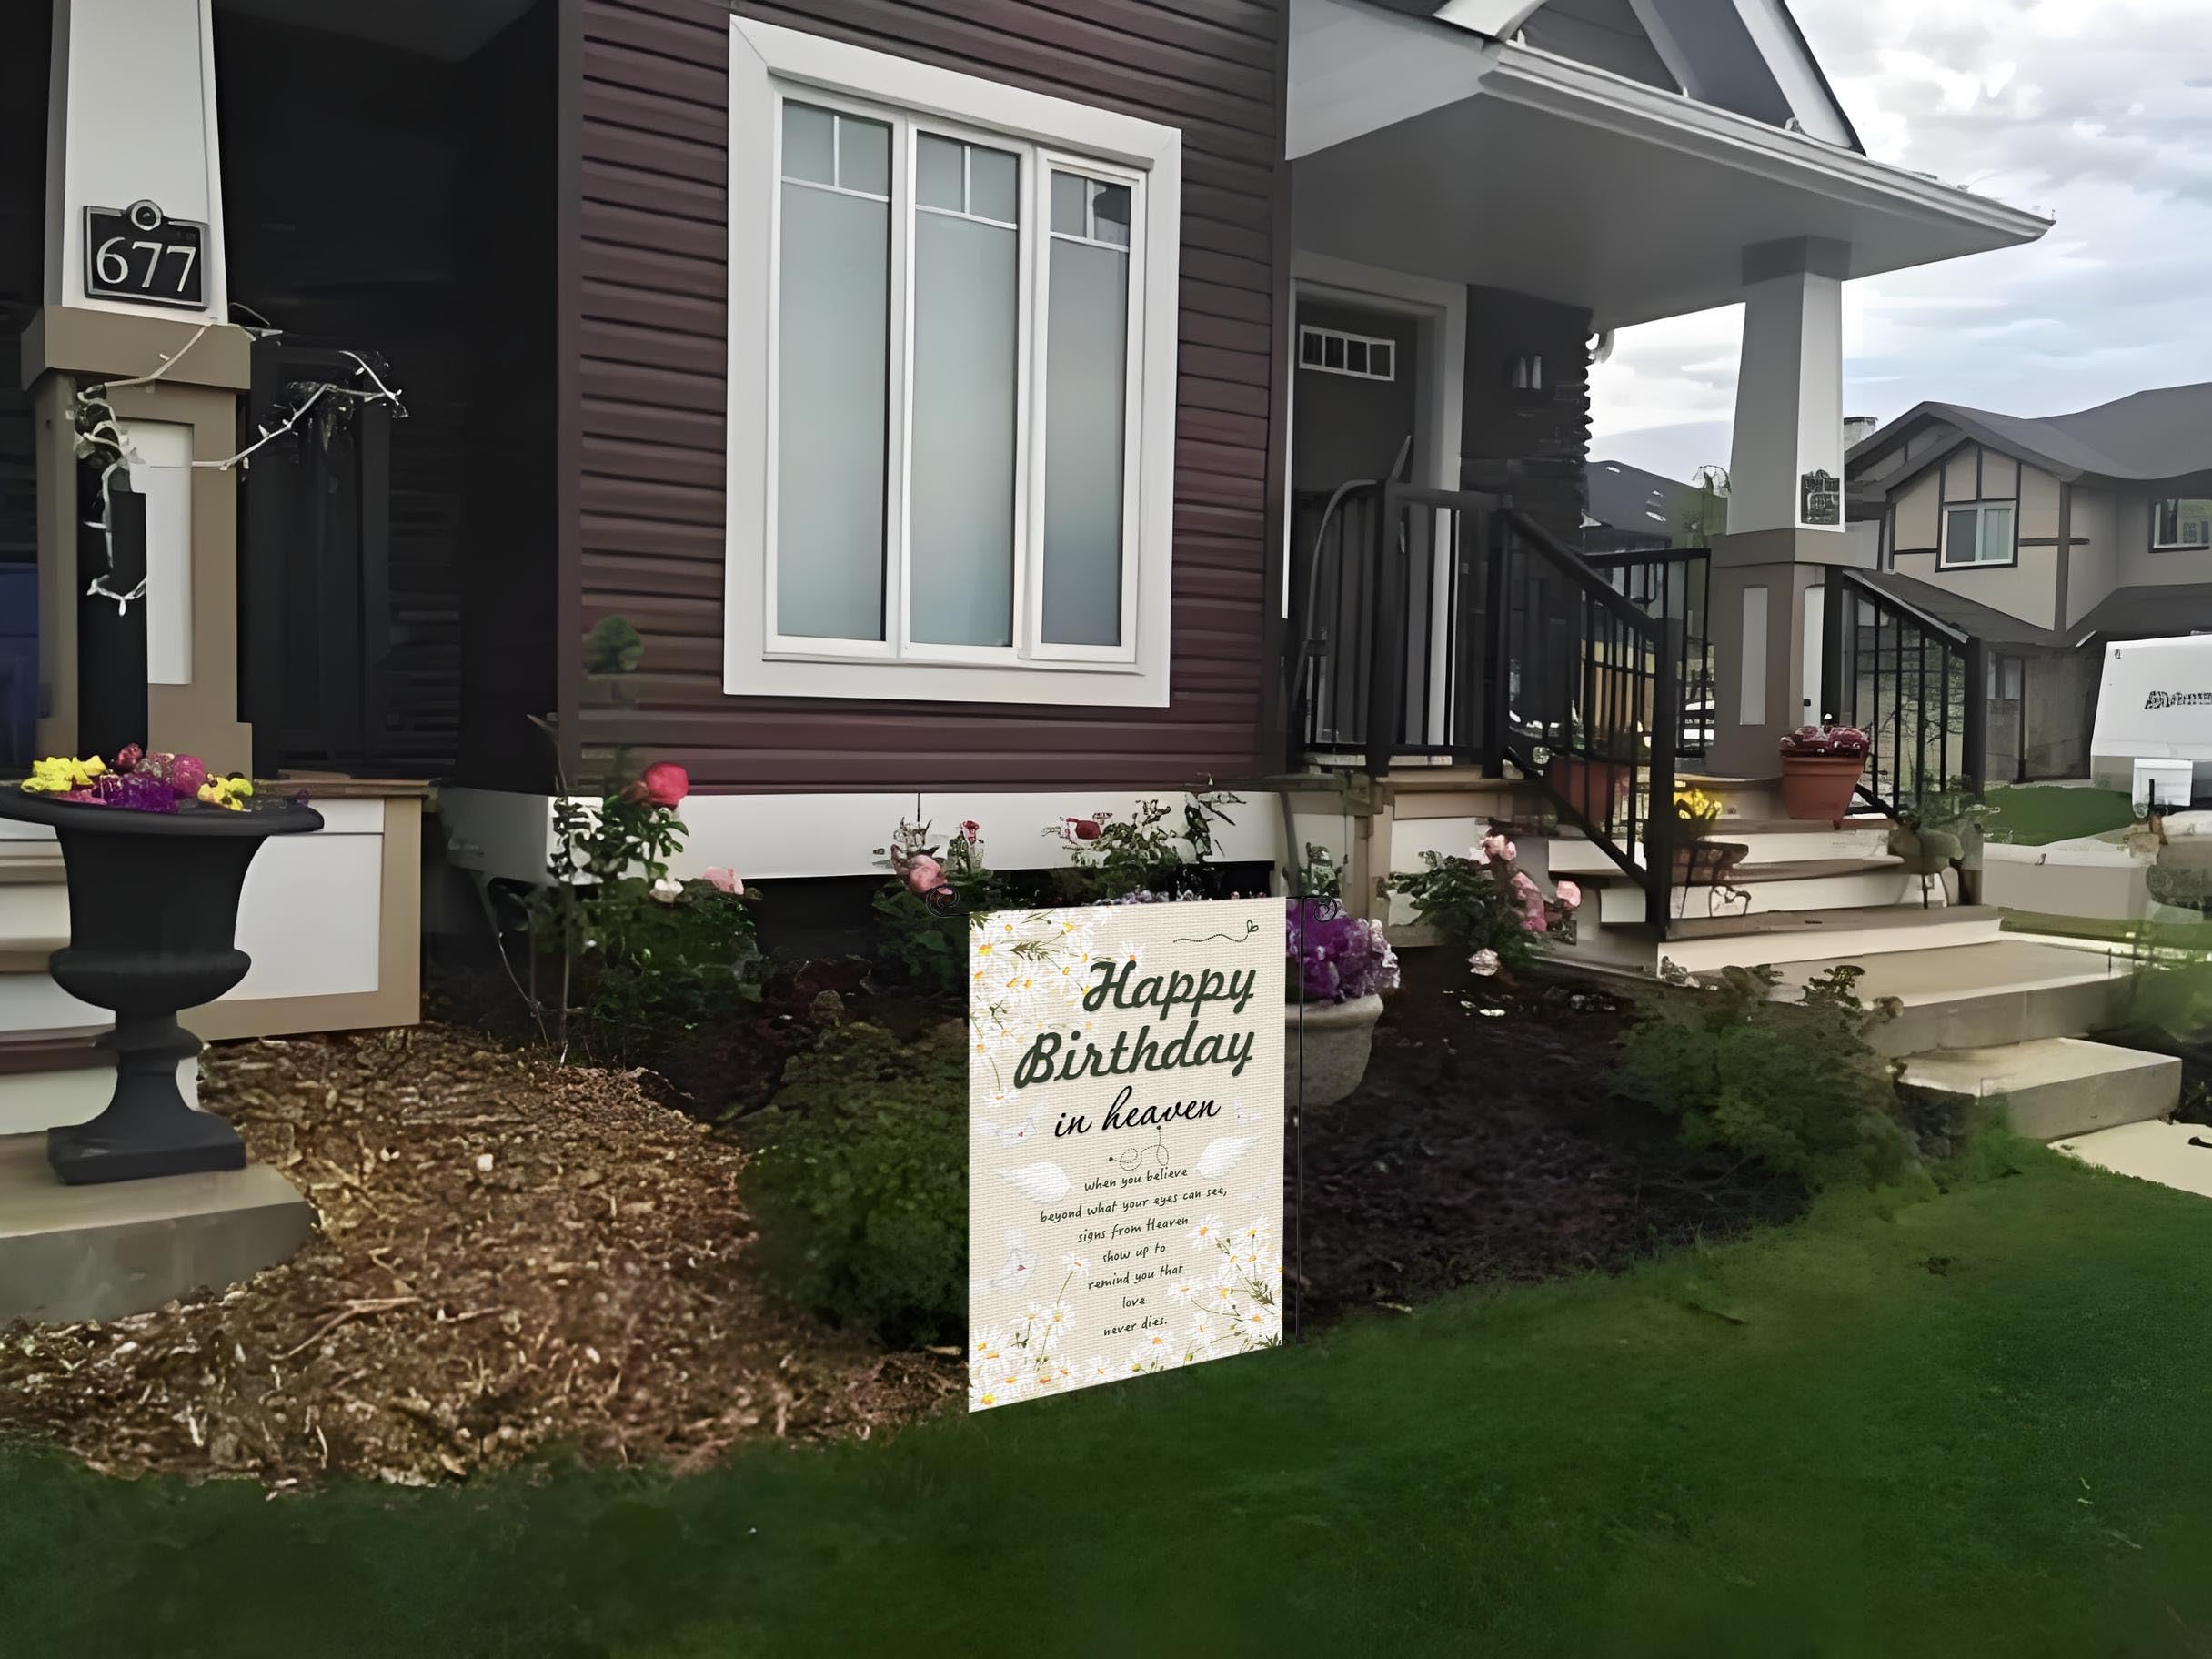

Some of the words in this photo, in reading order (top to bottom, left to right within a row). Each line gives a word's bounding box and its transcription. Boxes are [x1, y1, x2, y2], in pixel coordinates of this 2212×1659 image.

[96, 236, 196, 292] 677
[1082, 960, 1257, 1021] Happy
[1014, 1019, 1255, 1089] Birthday
[1054, 1111, 1092, 1138] in
[1101, 1085, 1222, 1131] heaven
[1084, 1177, 1116, 1191] when
[1121, 1176, 1141, 1190] you
[1146, 1166, 1188, 1182] believe
[1041, 1205, 1082, 1223] beyond
[1087, 1200, 1118, 1215] what
[1121, 1200, 1149, 1212] your
[1152, 1192, 1178, 1206] eyes
[1182, 1191, 1202, 1201] can
[1206, 1187, 1228, 1198] see,
[1078, 1229, 1106, 1243] signs
[1111, 1223, 1141, 1240] from
[1146, 1216, 1189, 1231] Heaven
[1101, 1250, 1131, 1263] show
[1135, 1246, 1149, 1258] up
[1154, 1242, 1166, 1253] to
[1088, 1272, 1130, 1290] remind
[1133, 1272, 1154, 1284] you
[1160, 1262, 1183, 1277] that
[1122, 1296, 1145, 1309] love
[1103, 1322, 1137, 1336] never
[1141, 1315, 1168, 1330] dies.
